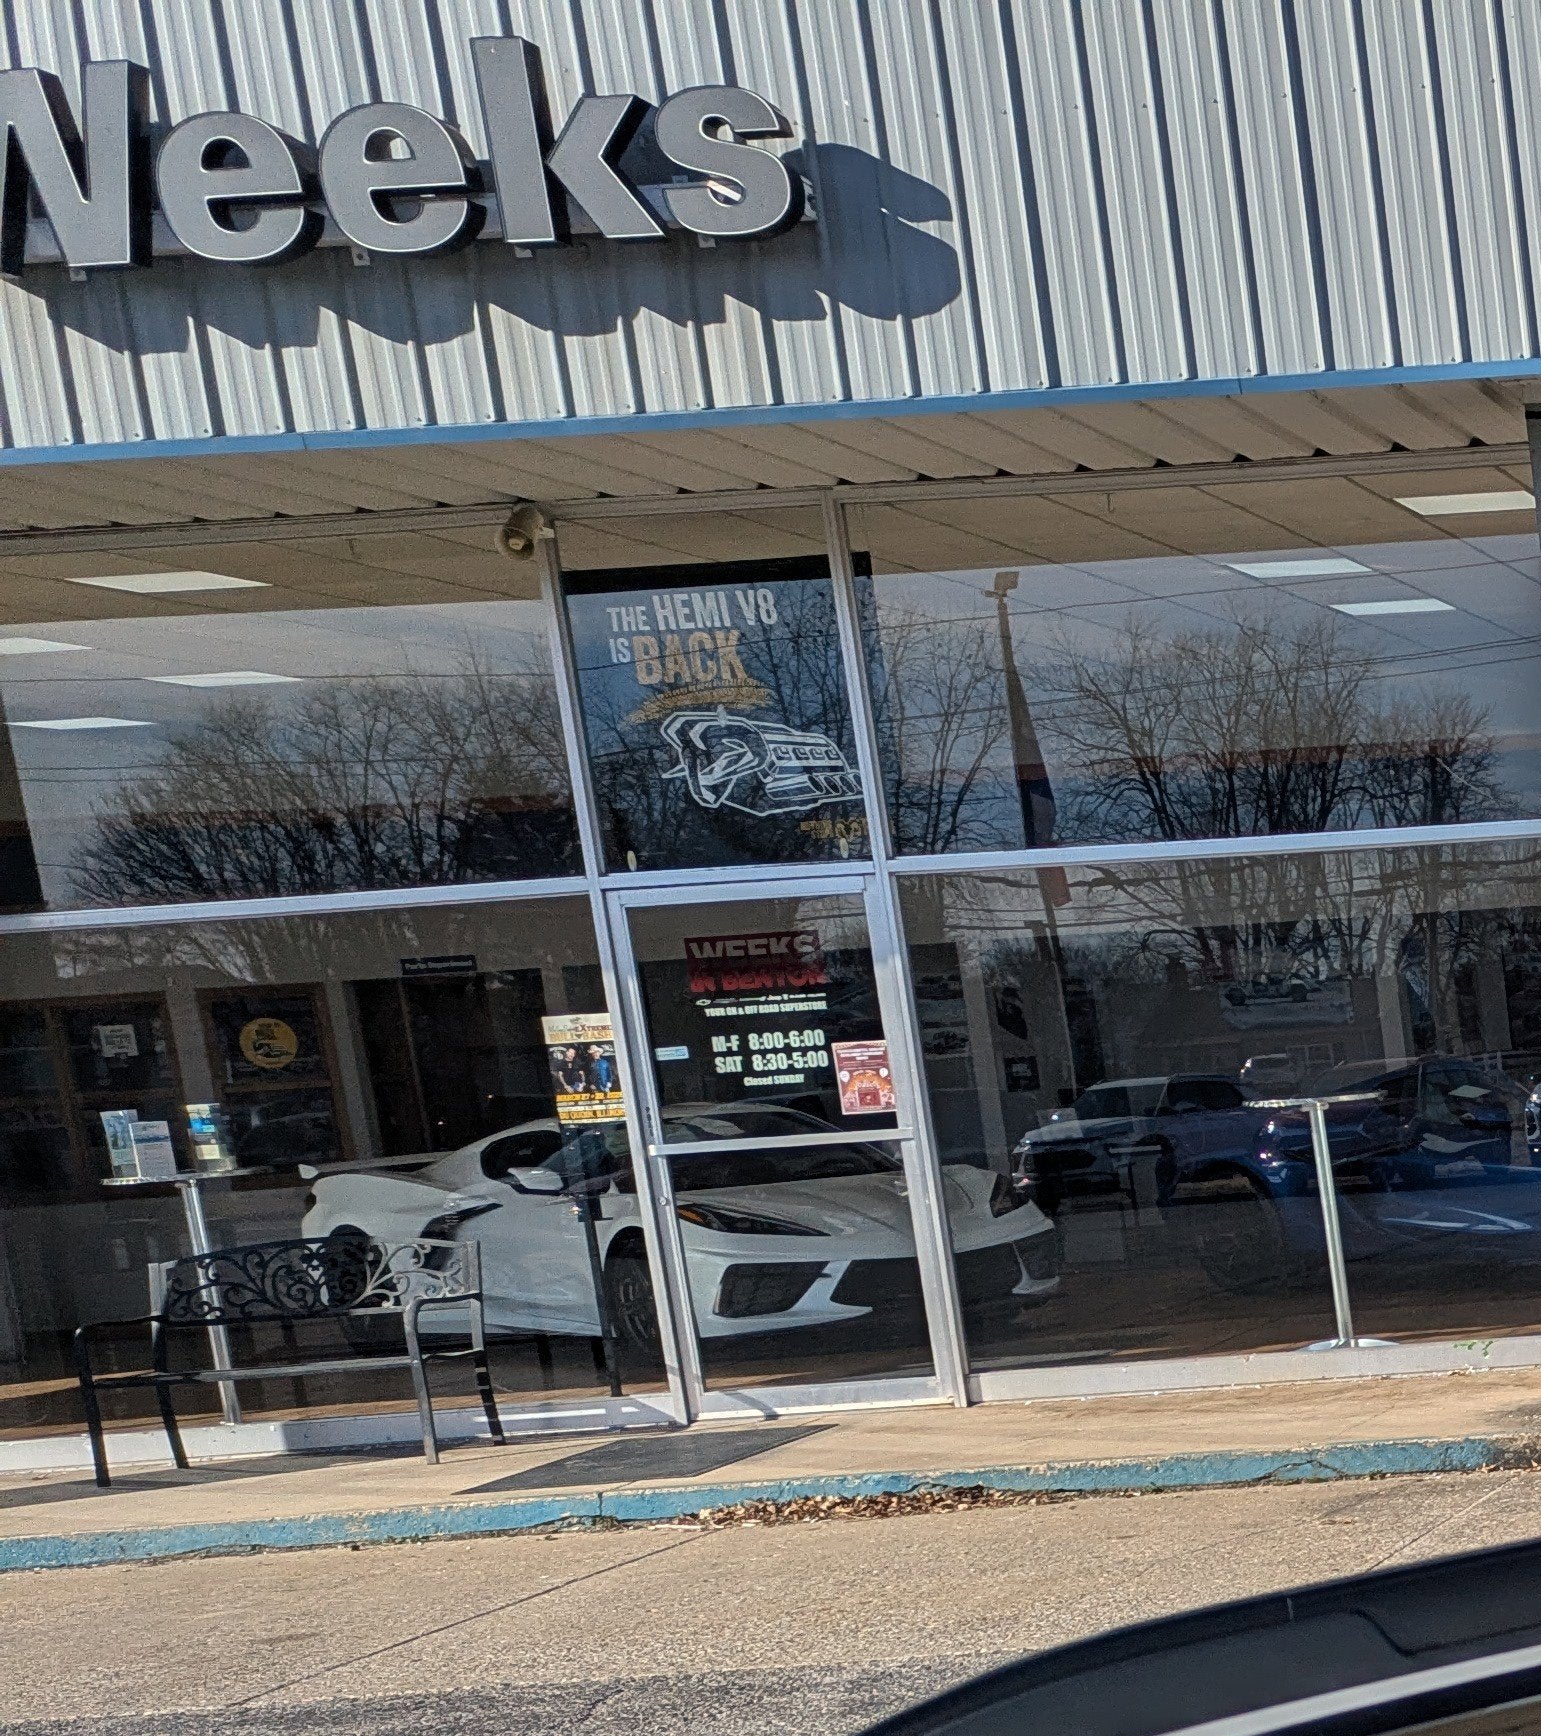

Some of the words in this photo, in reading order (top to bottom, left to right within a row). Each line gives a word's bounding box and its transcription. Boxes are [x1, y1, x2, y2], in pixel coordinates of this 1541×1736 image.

[607, 605, 650, 632] THE
[652, 591, 731, 631] HEMI
[735, 588, 778, 626] V8
[609, 637, 631, 663] IS
[632, 629, 748, 685] BACK
[689, 934, 818, 962] WEEKS
[711, 1034, 740, 1053] M-F
[747, 1028, 826, 1050] 8:00-6:00
[714, 1055, 743, 1074] SAT
[751, 1050, 830, 1072] 8:30-5:00
[743, 1076, 773, 1087] Closed
